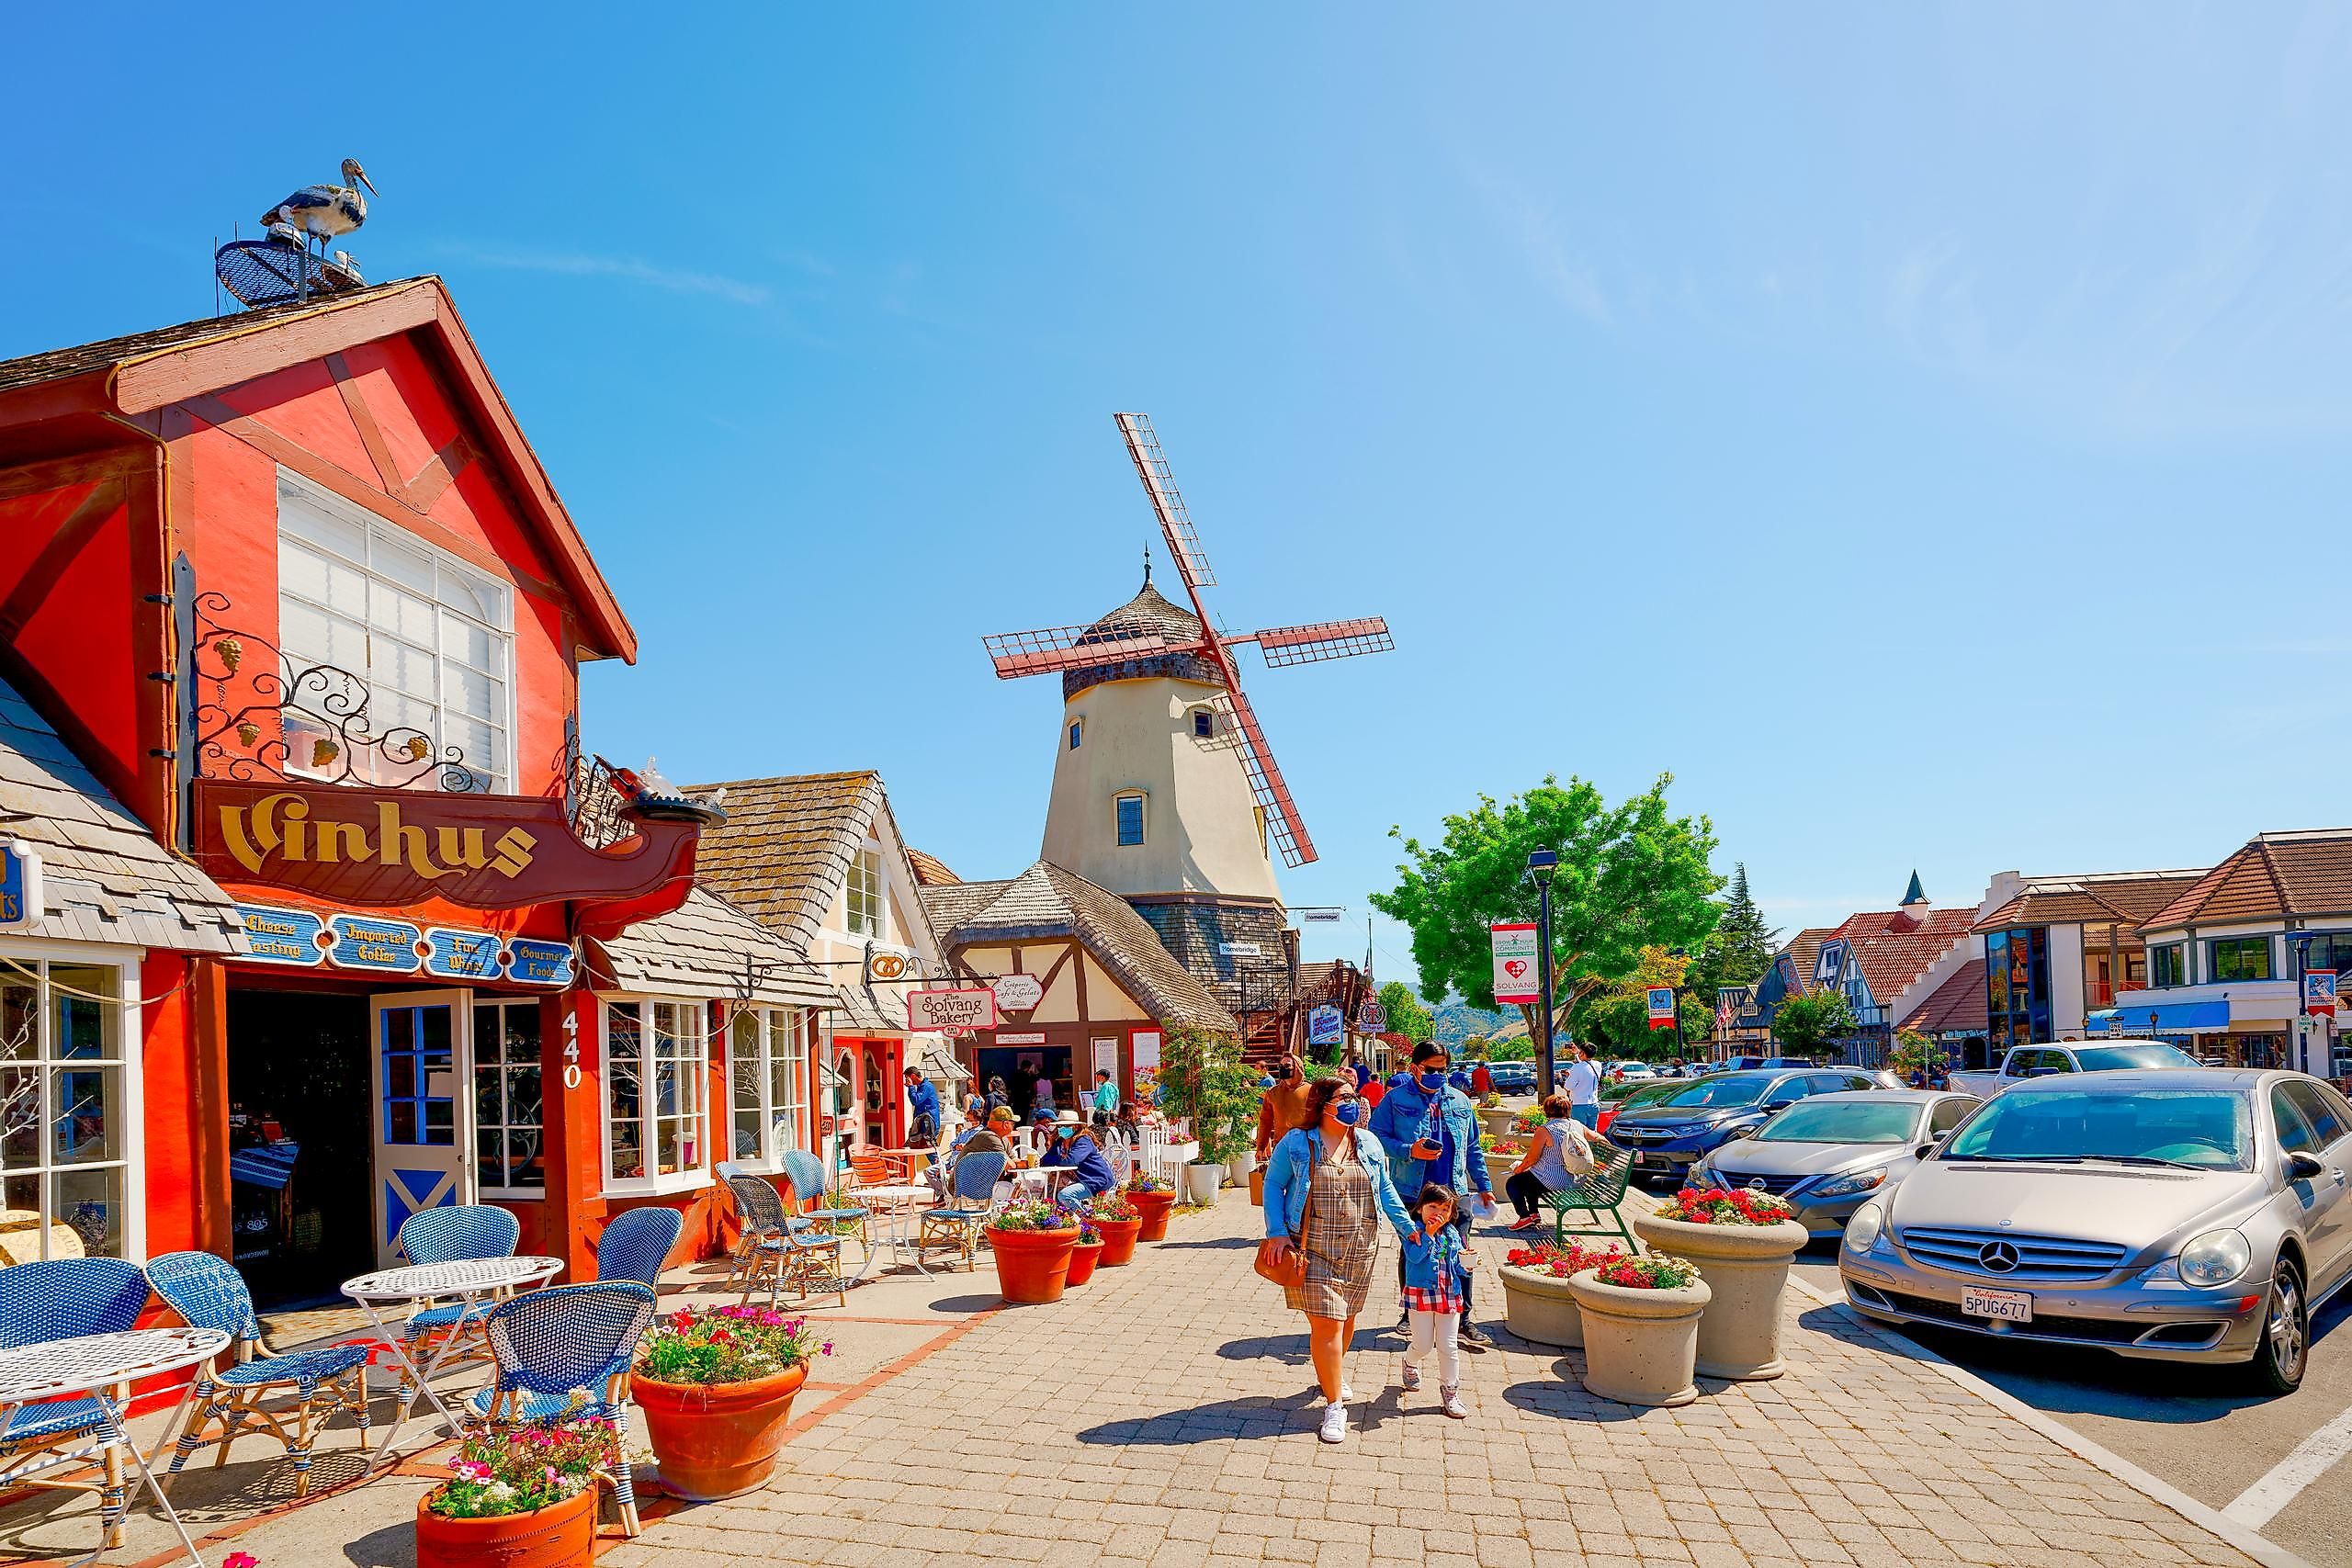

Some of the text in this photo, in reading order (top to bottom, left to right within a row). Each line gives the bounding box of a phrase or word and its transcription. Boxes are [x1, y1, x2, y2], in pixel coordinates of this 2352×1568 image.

[220, 793, 538, 878] Vinhus
[245, 915, 295, 935] Cheese
[345, 923, 408, 944] Imported
[251, 936, 300, 958] asting
[358, 945, 396, 963] Coffee
[454, 938, 479, 954] Fine
[520, 946, 563, 962] Gourmet
[1222, 945, 1257, 953] Homebridge
[528, 962, 557, 977] Foods
[922, 997, 982, 1014] Solvang
[931, 1011, 974, 1025] Bakery
[562, 1011, 582, 1089] 440
[1974, 1290, 2015, 1301] California
[1966, 1296, 2027, 1318] 5PUG677
